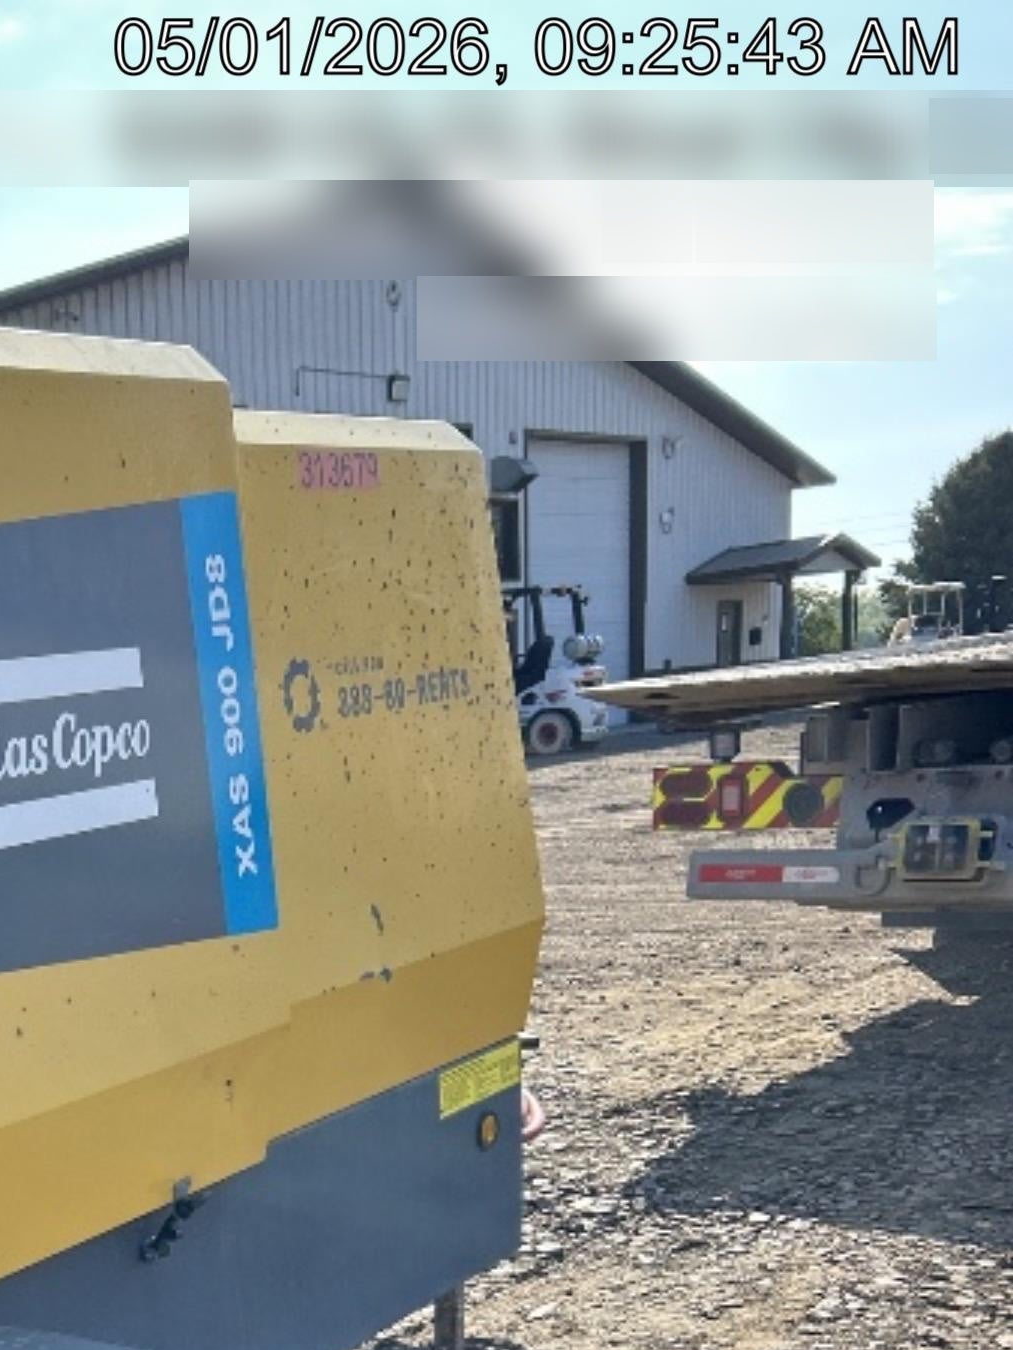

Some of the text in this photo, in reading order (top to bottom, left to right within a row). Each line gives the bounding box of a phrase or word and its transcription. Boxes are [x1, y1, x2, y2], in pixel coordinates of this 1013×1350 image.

[52, 711, 152, 778] Copco
[217, 667, 244, 757] 900
[229, 774, 259, 878] XAS
